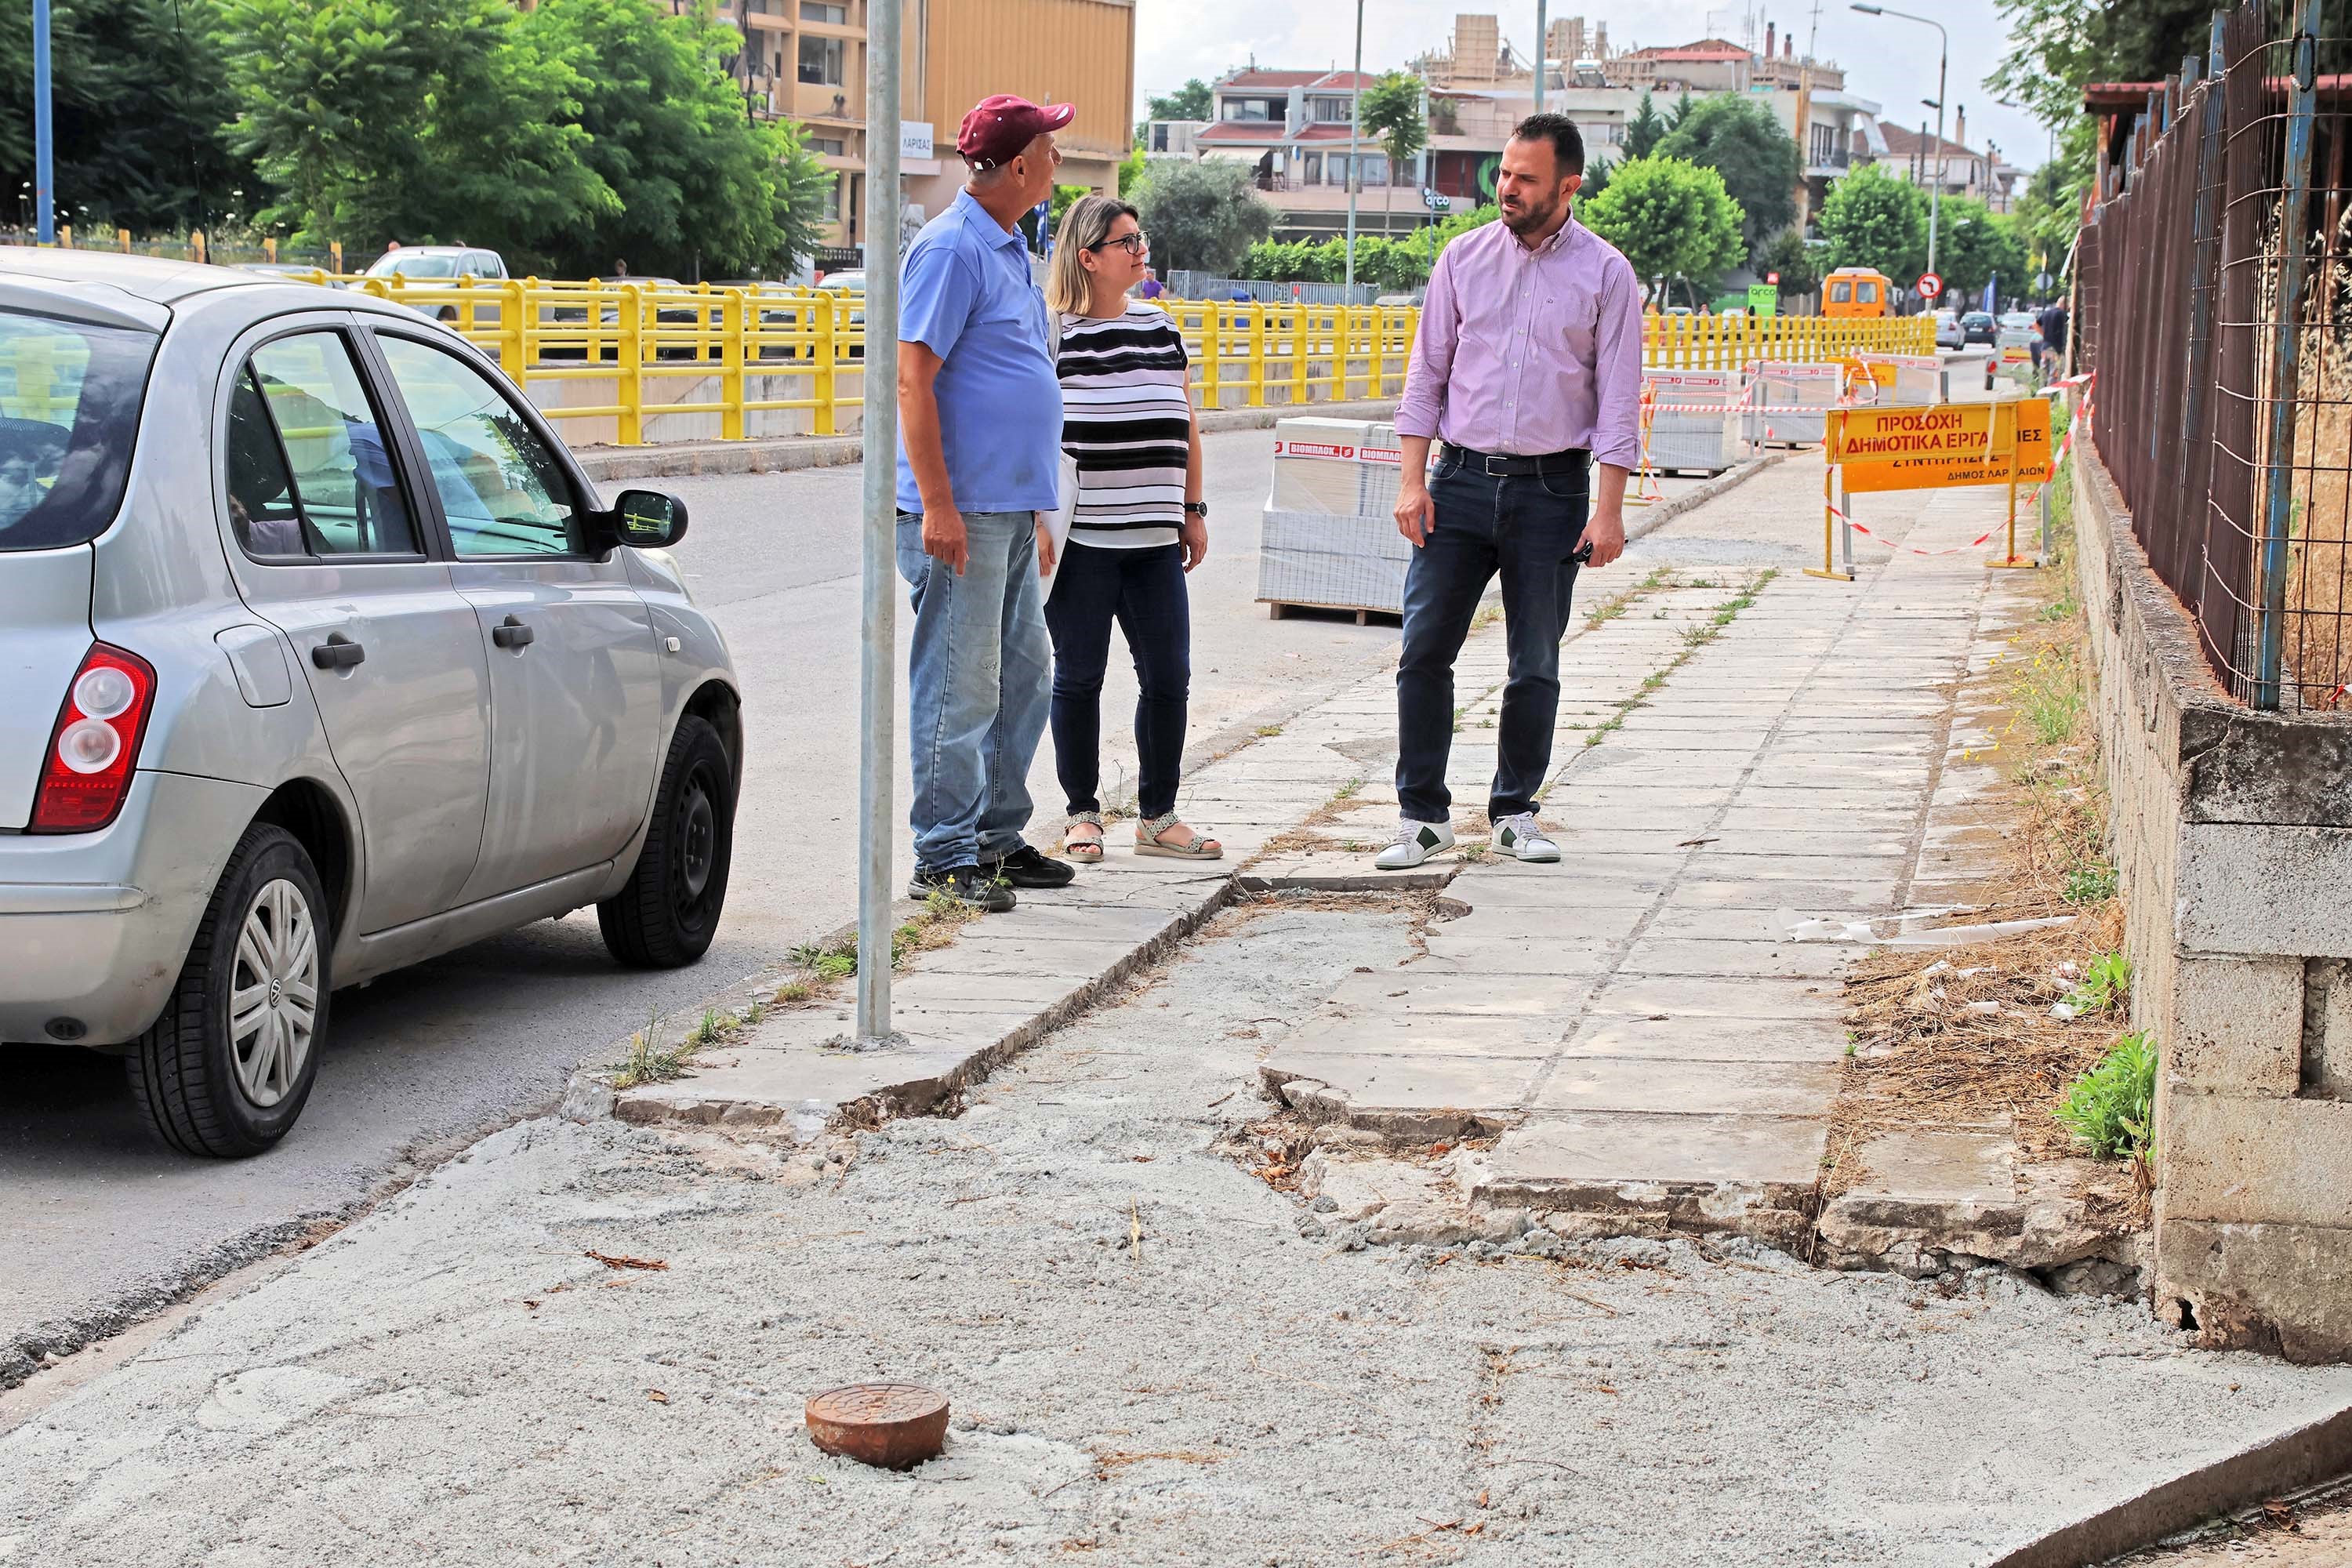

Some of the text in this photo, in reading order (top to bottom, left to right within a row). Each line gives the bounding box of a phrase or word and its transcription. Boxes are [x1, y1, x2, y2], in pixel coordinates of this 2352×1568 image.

[902, 137, 931, 151] ΛΑΡΙΣΑΣ
[1751, 288, 1776, 298] arco
[1877, 414, 1962, 432] ΠΡΟΣΟΧΗ
[1846, 431, 1989, 453] ΔΗΜΟΤΙΚΑ ΕΡΓΑ
[1361, 449, 1401, 462] ΒΙΟΜΠΛΟ
[1947, 466, 2045, 481] ΔΗΜΟΣ ΛΑΡΑΙΩΝ
